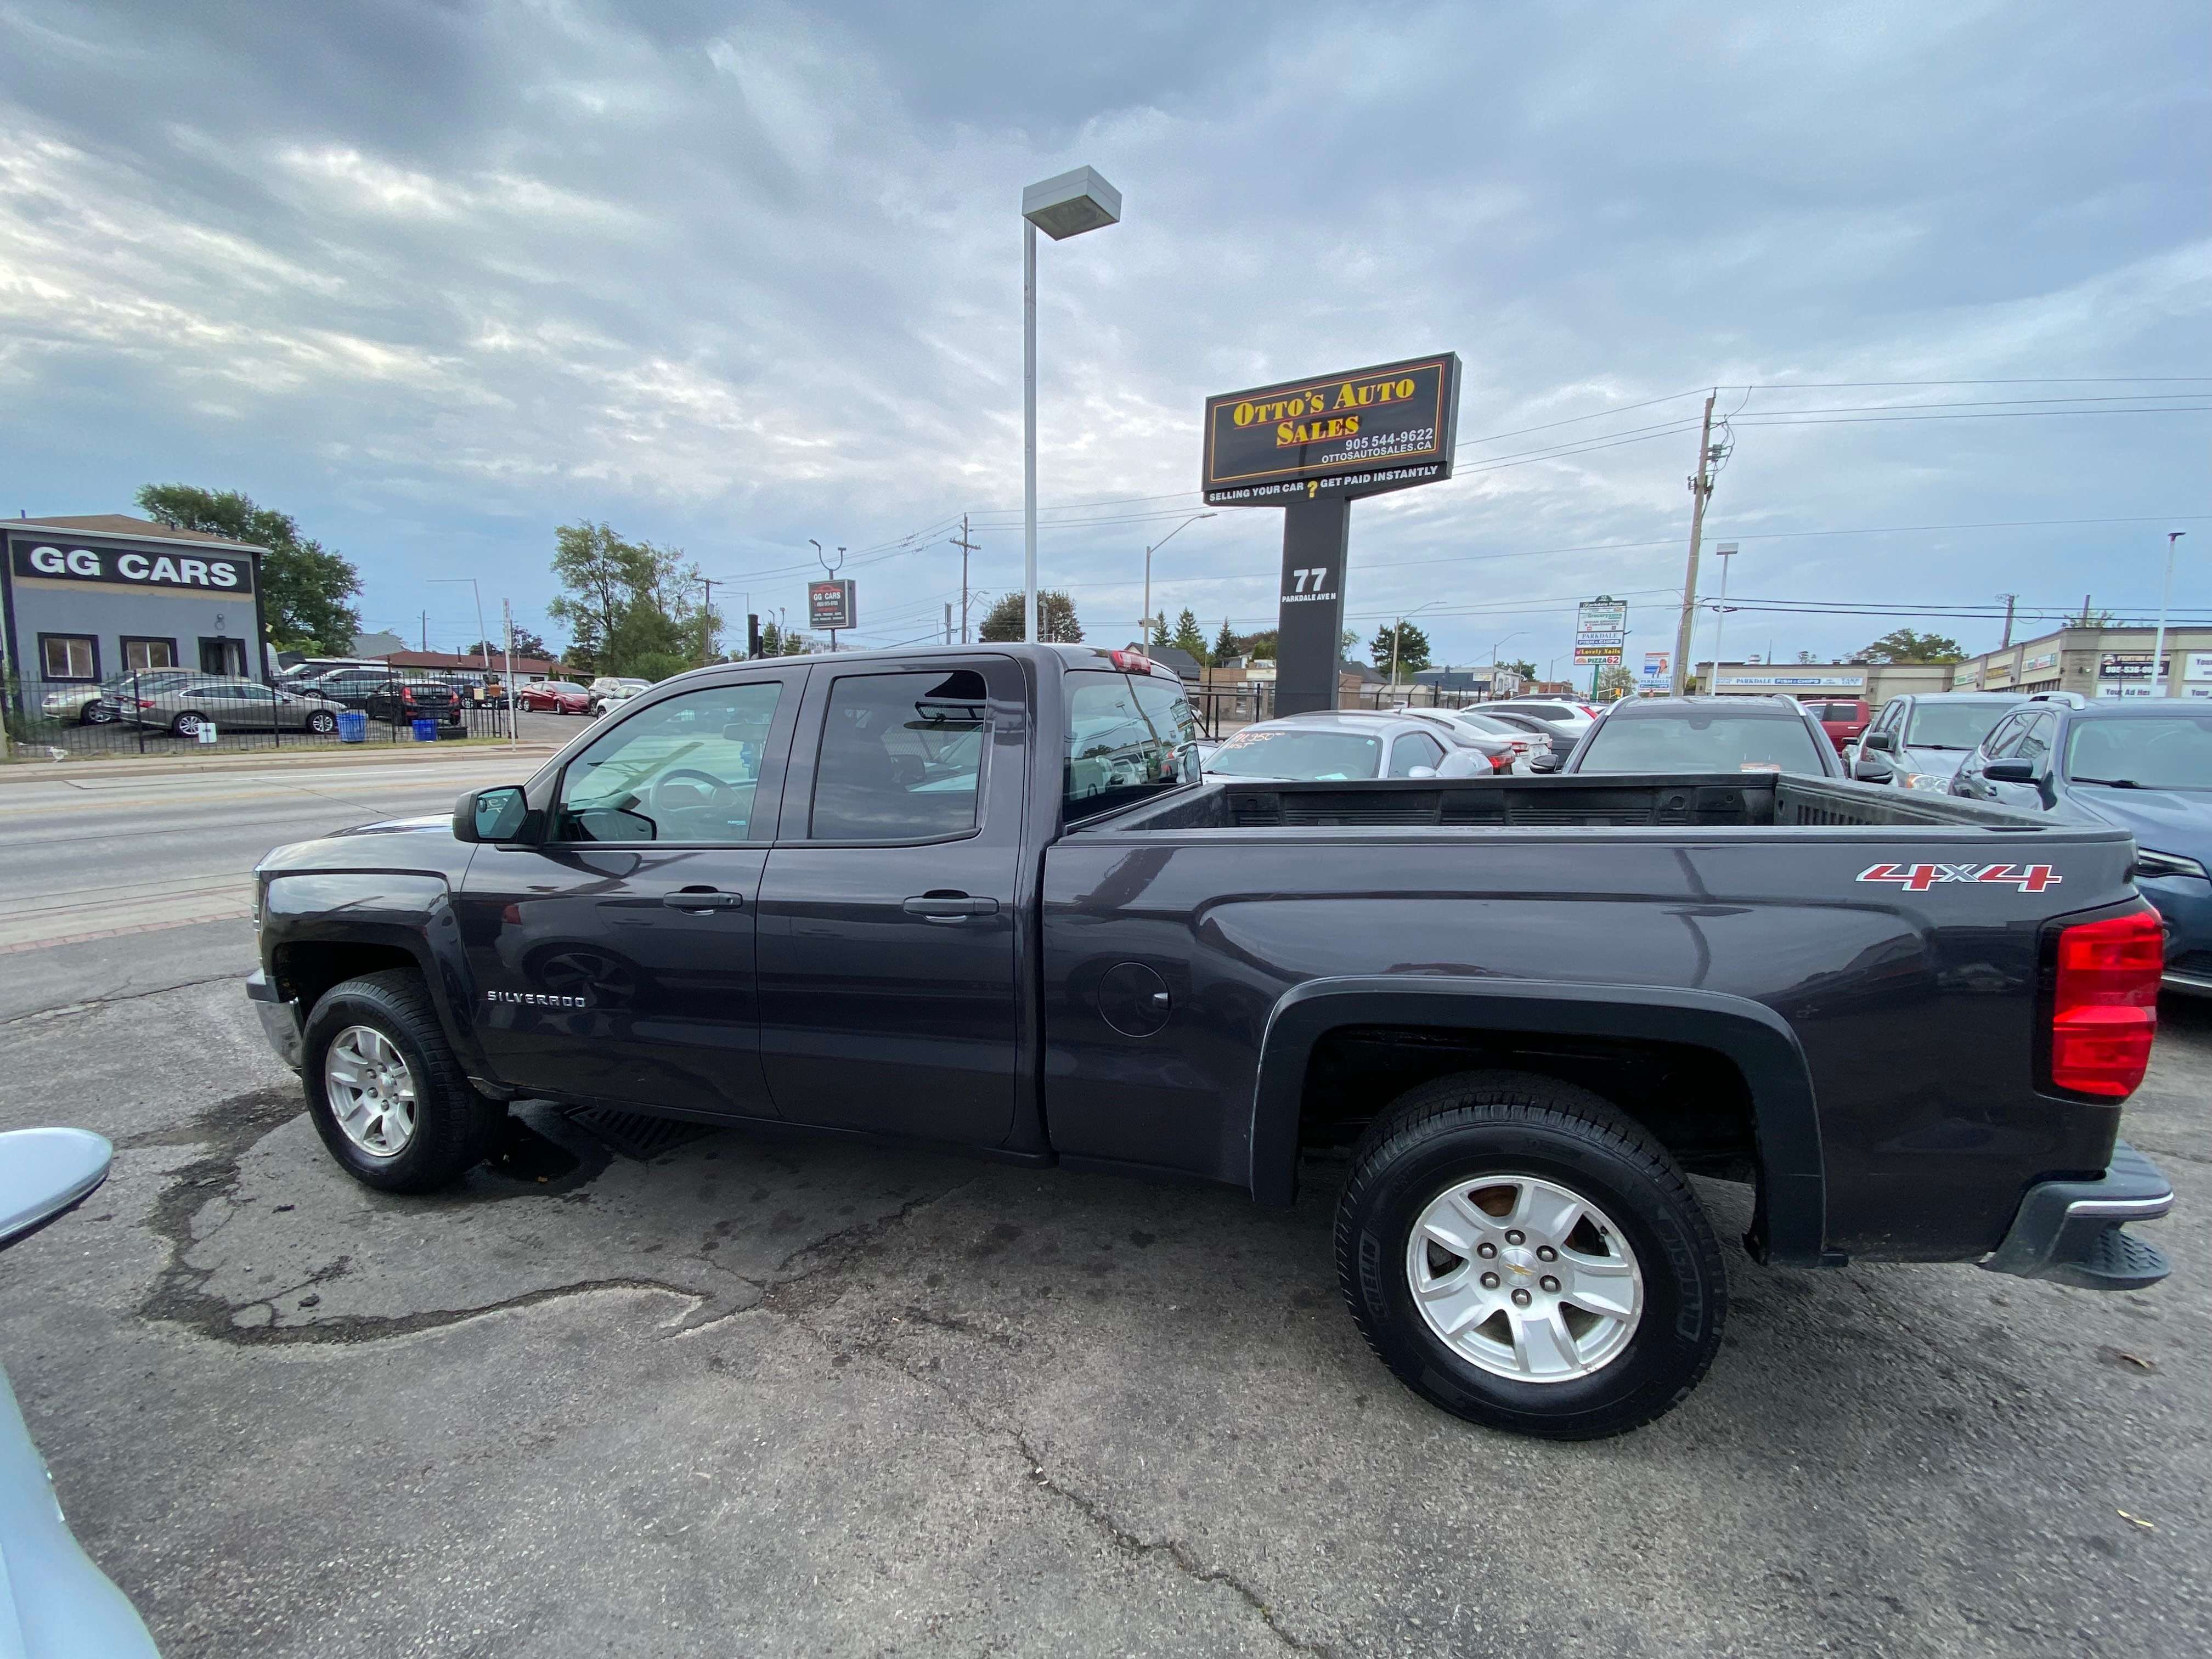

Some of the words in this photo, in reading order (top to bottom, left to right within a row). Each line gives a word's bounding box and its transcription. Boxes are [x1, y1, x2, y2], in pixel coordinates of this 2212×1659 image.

[1345, 437, 1369, 451] 905
[1371, 427, 1434, 446] 544-9622
[1321, 441, 1432, 464] OTTOSAUTOSALES.CA
[1209, 488, 1250, 502] SELLING
[1252, 484, 1280, 496] YOUR
[1282, 482, 1304, 493] CAR
[1320, 478, 1342, 488] GET
[1344, 474, 1371, 486] PAID
[1373, 465, 1438, 482] INSTANTLY
[30, 546, 102, 576] GG
[117, 554, 238, 587] CARS
[1294, 567, 1327, 593] 77
[824, 591, 841, 600] CARS
[1282, 594, 1316, 603] PARKDALE
[487, 990, 585, 1008] SILVERADO
